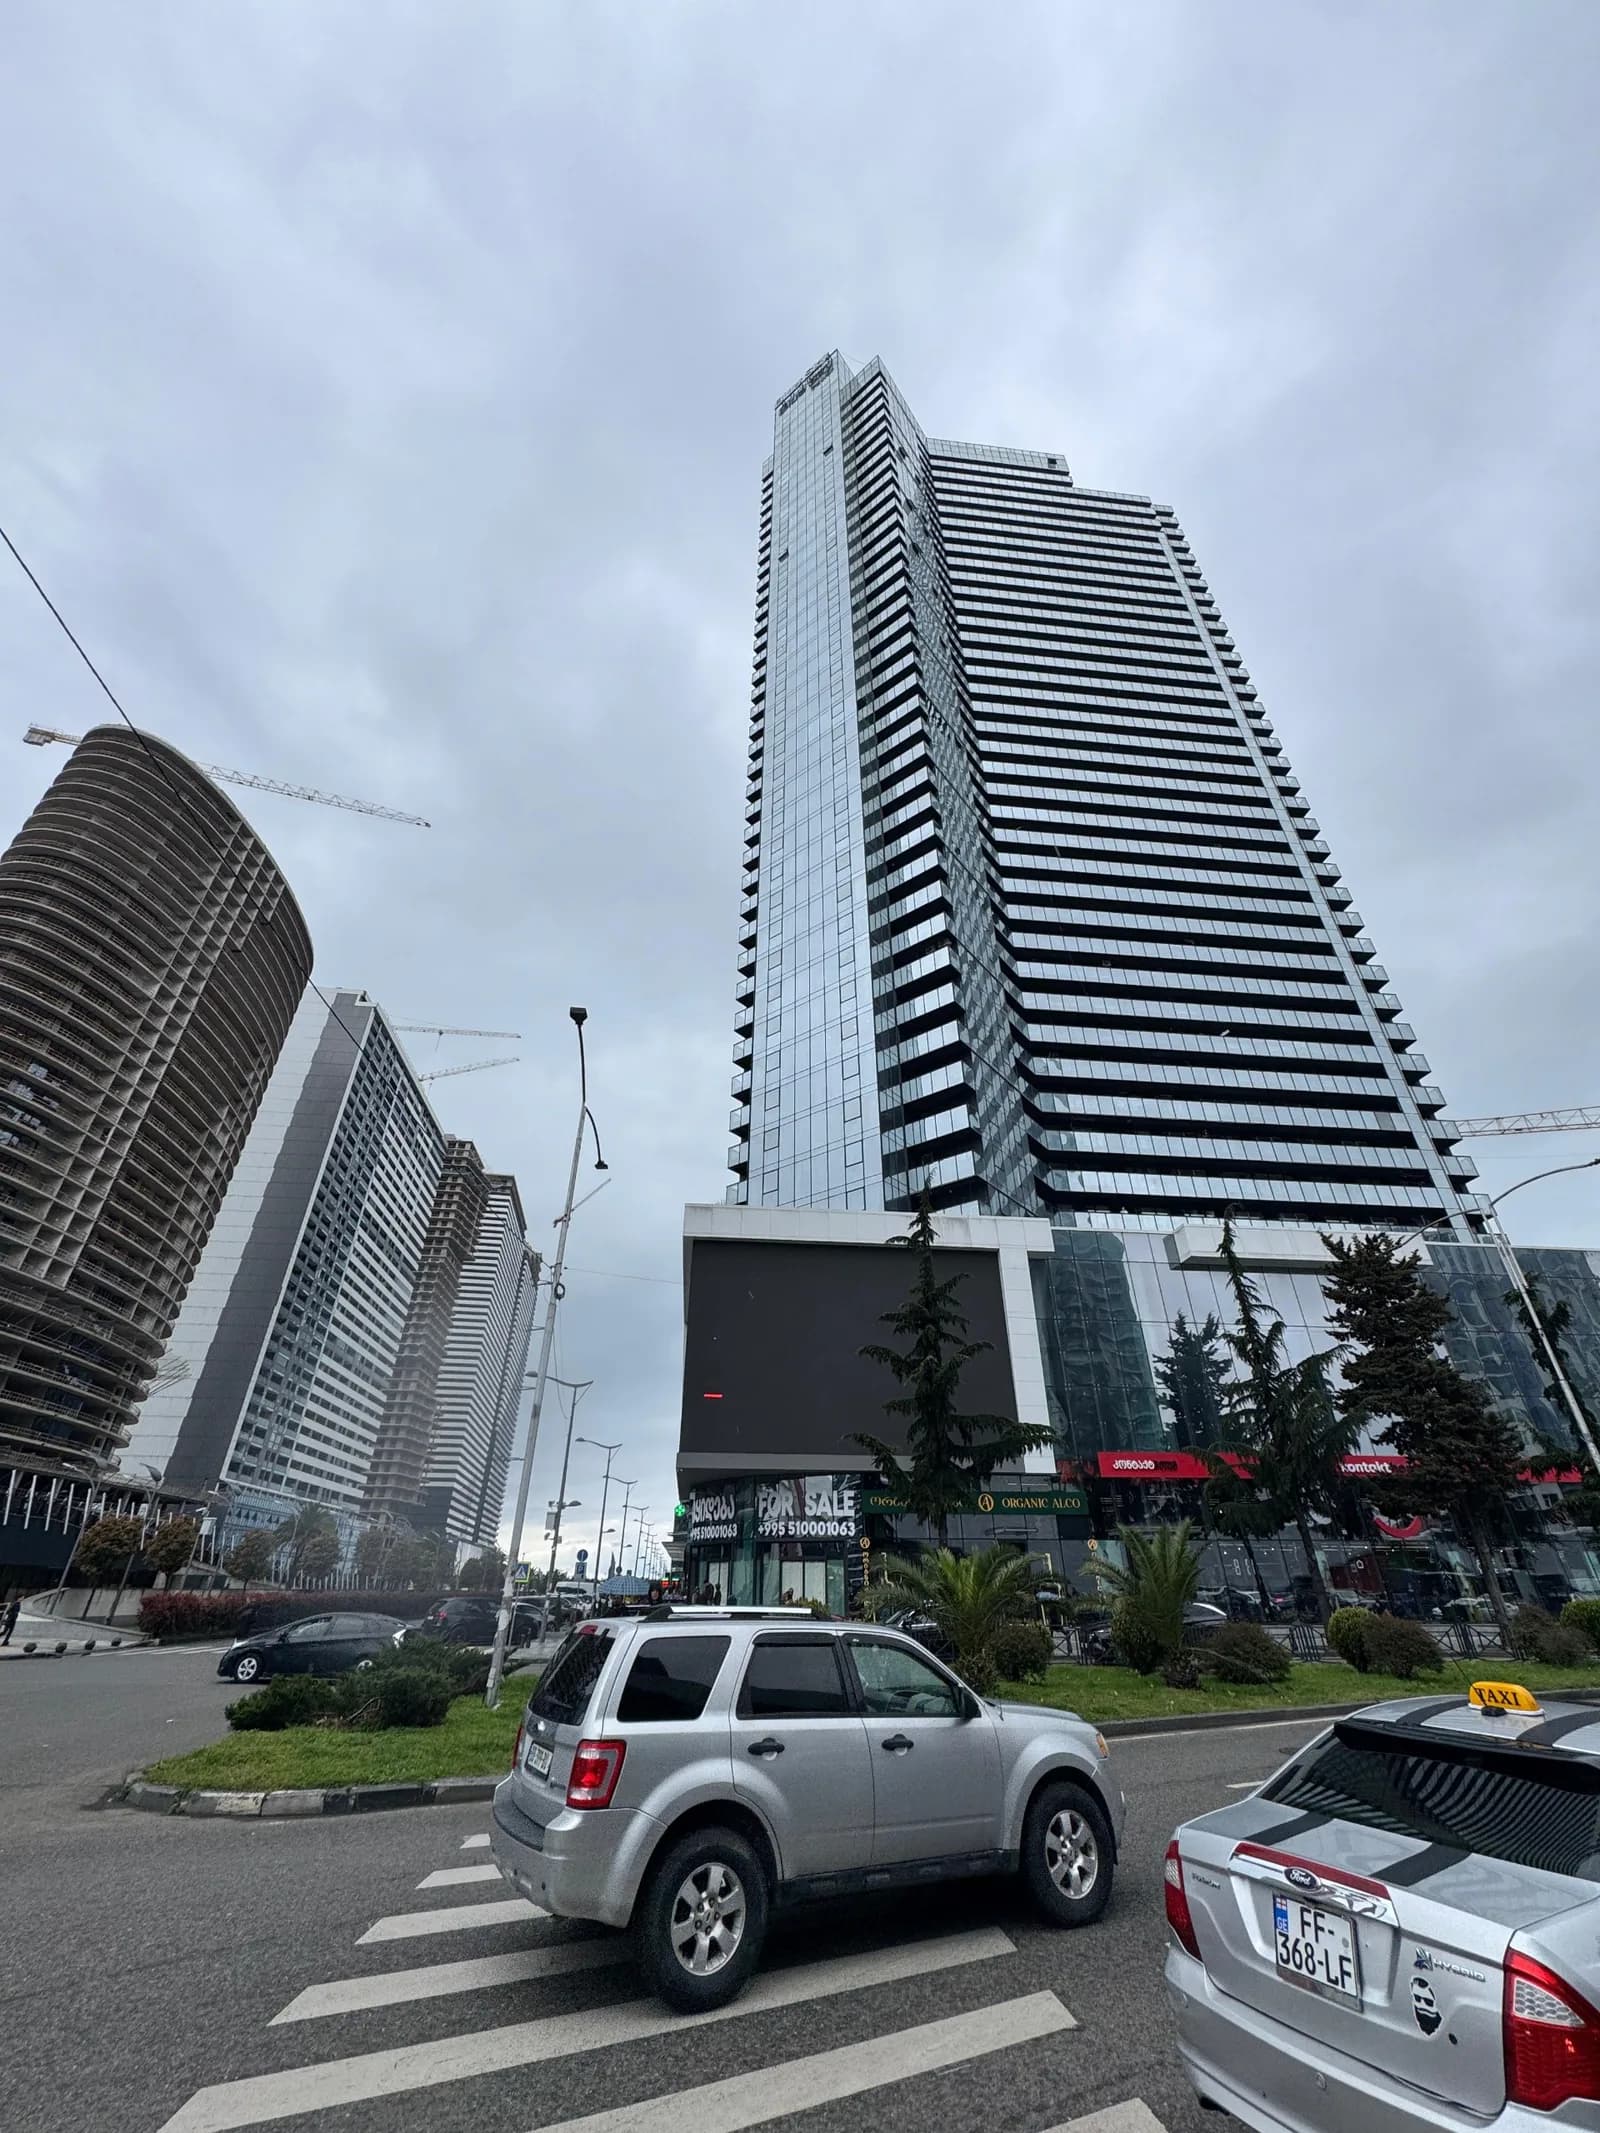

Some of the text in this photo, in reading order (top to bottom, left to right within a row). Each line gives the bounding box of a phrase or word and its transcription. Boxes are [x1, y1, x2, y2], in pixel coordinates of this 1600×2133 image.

[758, 1489, 794, 1517] FOR
[804, 1489, 855, 1517] SALE
[1001, 1497, 1081, 1509] ORGANIC ALCO
[701, 1523, 738, 1539] 510001063
[758, 1521, 855, 1537] +995 510001063
[1474, 1687, 1522, 1707] TAXI
[1289, 1869, 1311, 1886] Ford
[1276, 1916, 1288, 1934] GE
[1279, 1931, 1352, 1989] 368-LF
[1433, 1958, 1486, 1982] HYBRID
